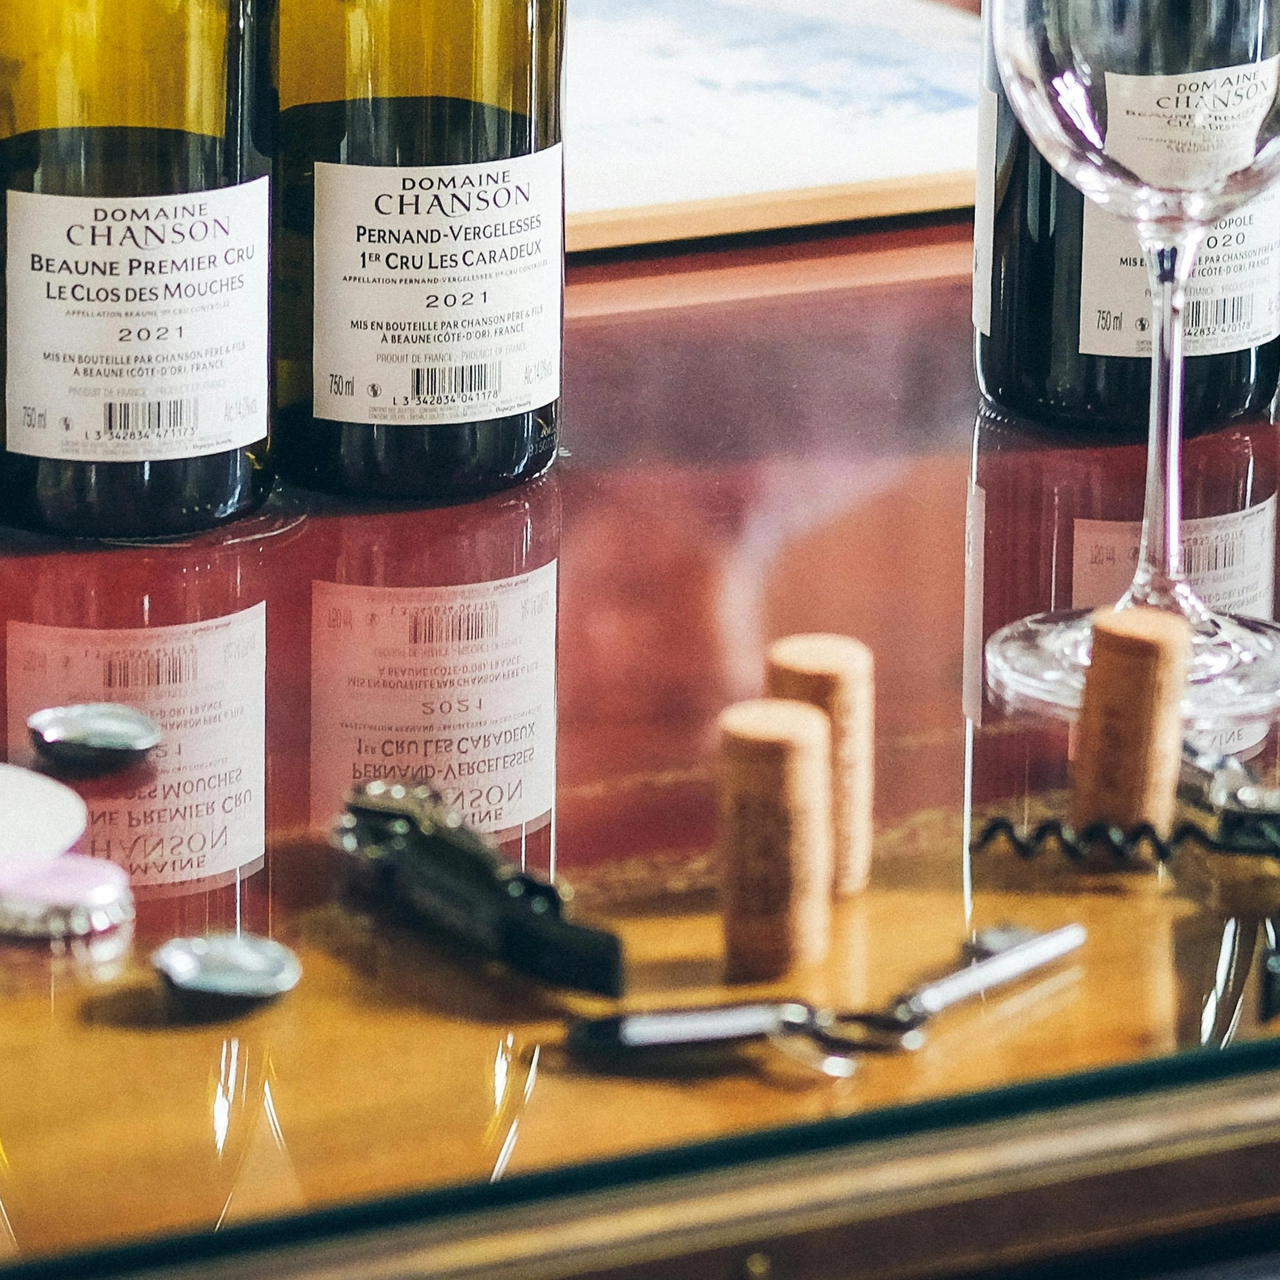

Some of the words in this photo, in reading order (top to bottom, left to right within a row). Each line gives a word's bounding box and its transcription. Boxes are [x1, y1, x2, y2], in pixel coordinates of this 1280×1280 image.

[1176, 70, 1260, 94] DOMAINE
[1155, 77, 1270, 113] CHANSON
[401, 170, 511, 191] DOMAINE
[373, 182, 531, 218] CHANSON
[93, 203, 208, 222] DOMAINE
[1213, 214, 1254, 231] NOPOLE
[65, 215, 231, 251] CHANSON
[355, 214, 542, 244] PERNAND-VERGELESSES
[1206, 231, 1246, 250] 020
[30, 253, 120, 277] BEAUNE
[128, 254, 218, 277] PREMIER
[223, 244, 256, 266] CRU
[385, 252, 424, 270] CRU
[428, 253, 458, 270] LES
[461, 239, 542, 267] CARADEUX
[1119, 257, 1138, 267] MIS
[1204, 253, 1221, 265] PAR
[1222, 248, 1258, 263] CHANSON
[45, 281, 67, 301] LE
[70, 284, 121, 303] CLOS
[125, 287, 159, 303] DES
[163, 274, 245, 300] MOUCHES
[342, 275, 398, 285] APPELLATION
[425, 291, 489, 309] 2021
[350, 320, 368, 330] MIS
[371, 321, 384, 331] EN
[385, 321, 439, 332] BOUTEILLE
[440, 320, 459, 331] PAR
[460, 315, 506, 329] CHANSON
[1096, 309, 1112, 331] 750
[118, 325, 184, 342] 2021
[391, 334, 432, 344] BEAUNE
[493, 323, 525, 337] FRANCE
[43, 351, 60, 363] MIS
[62, 352, 75, 364] EN
[77, 354, 131, 366] BOUTEILLE
[133, 355, 153, 364] PAR
[155, 350, 203, 364] CHANSON
[376, 353, 410, 364] PRODUIT
[411, 353, 422, 364] DE
[83, 366, 124, 378] BEAUNE
[191, 359, 225, 373] FRANCE
[329, 374, 344, 396] 750
[345, 376, 355, 397] ml
[402, 397, 410, 406] 3
[415, 396, 456, 406] 342834
